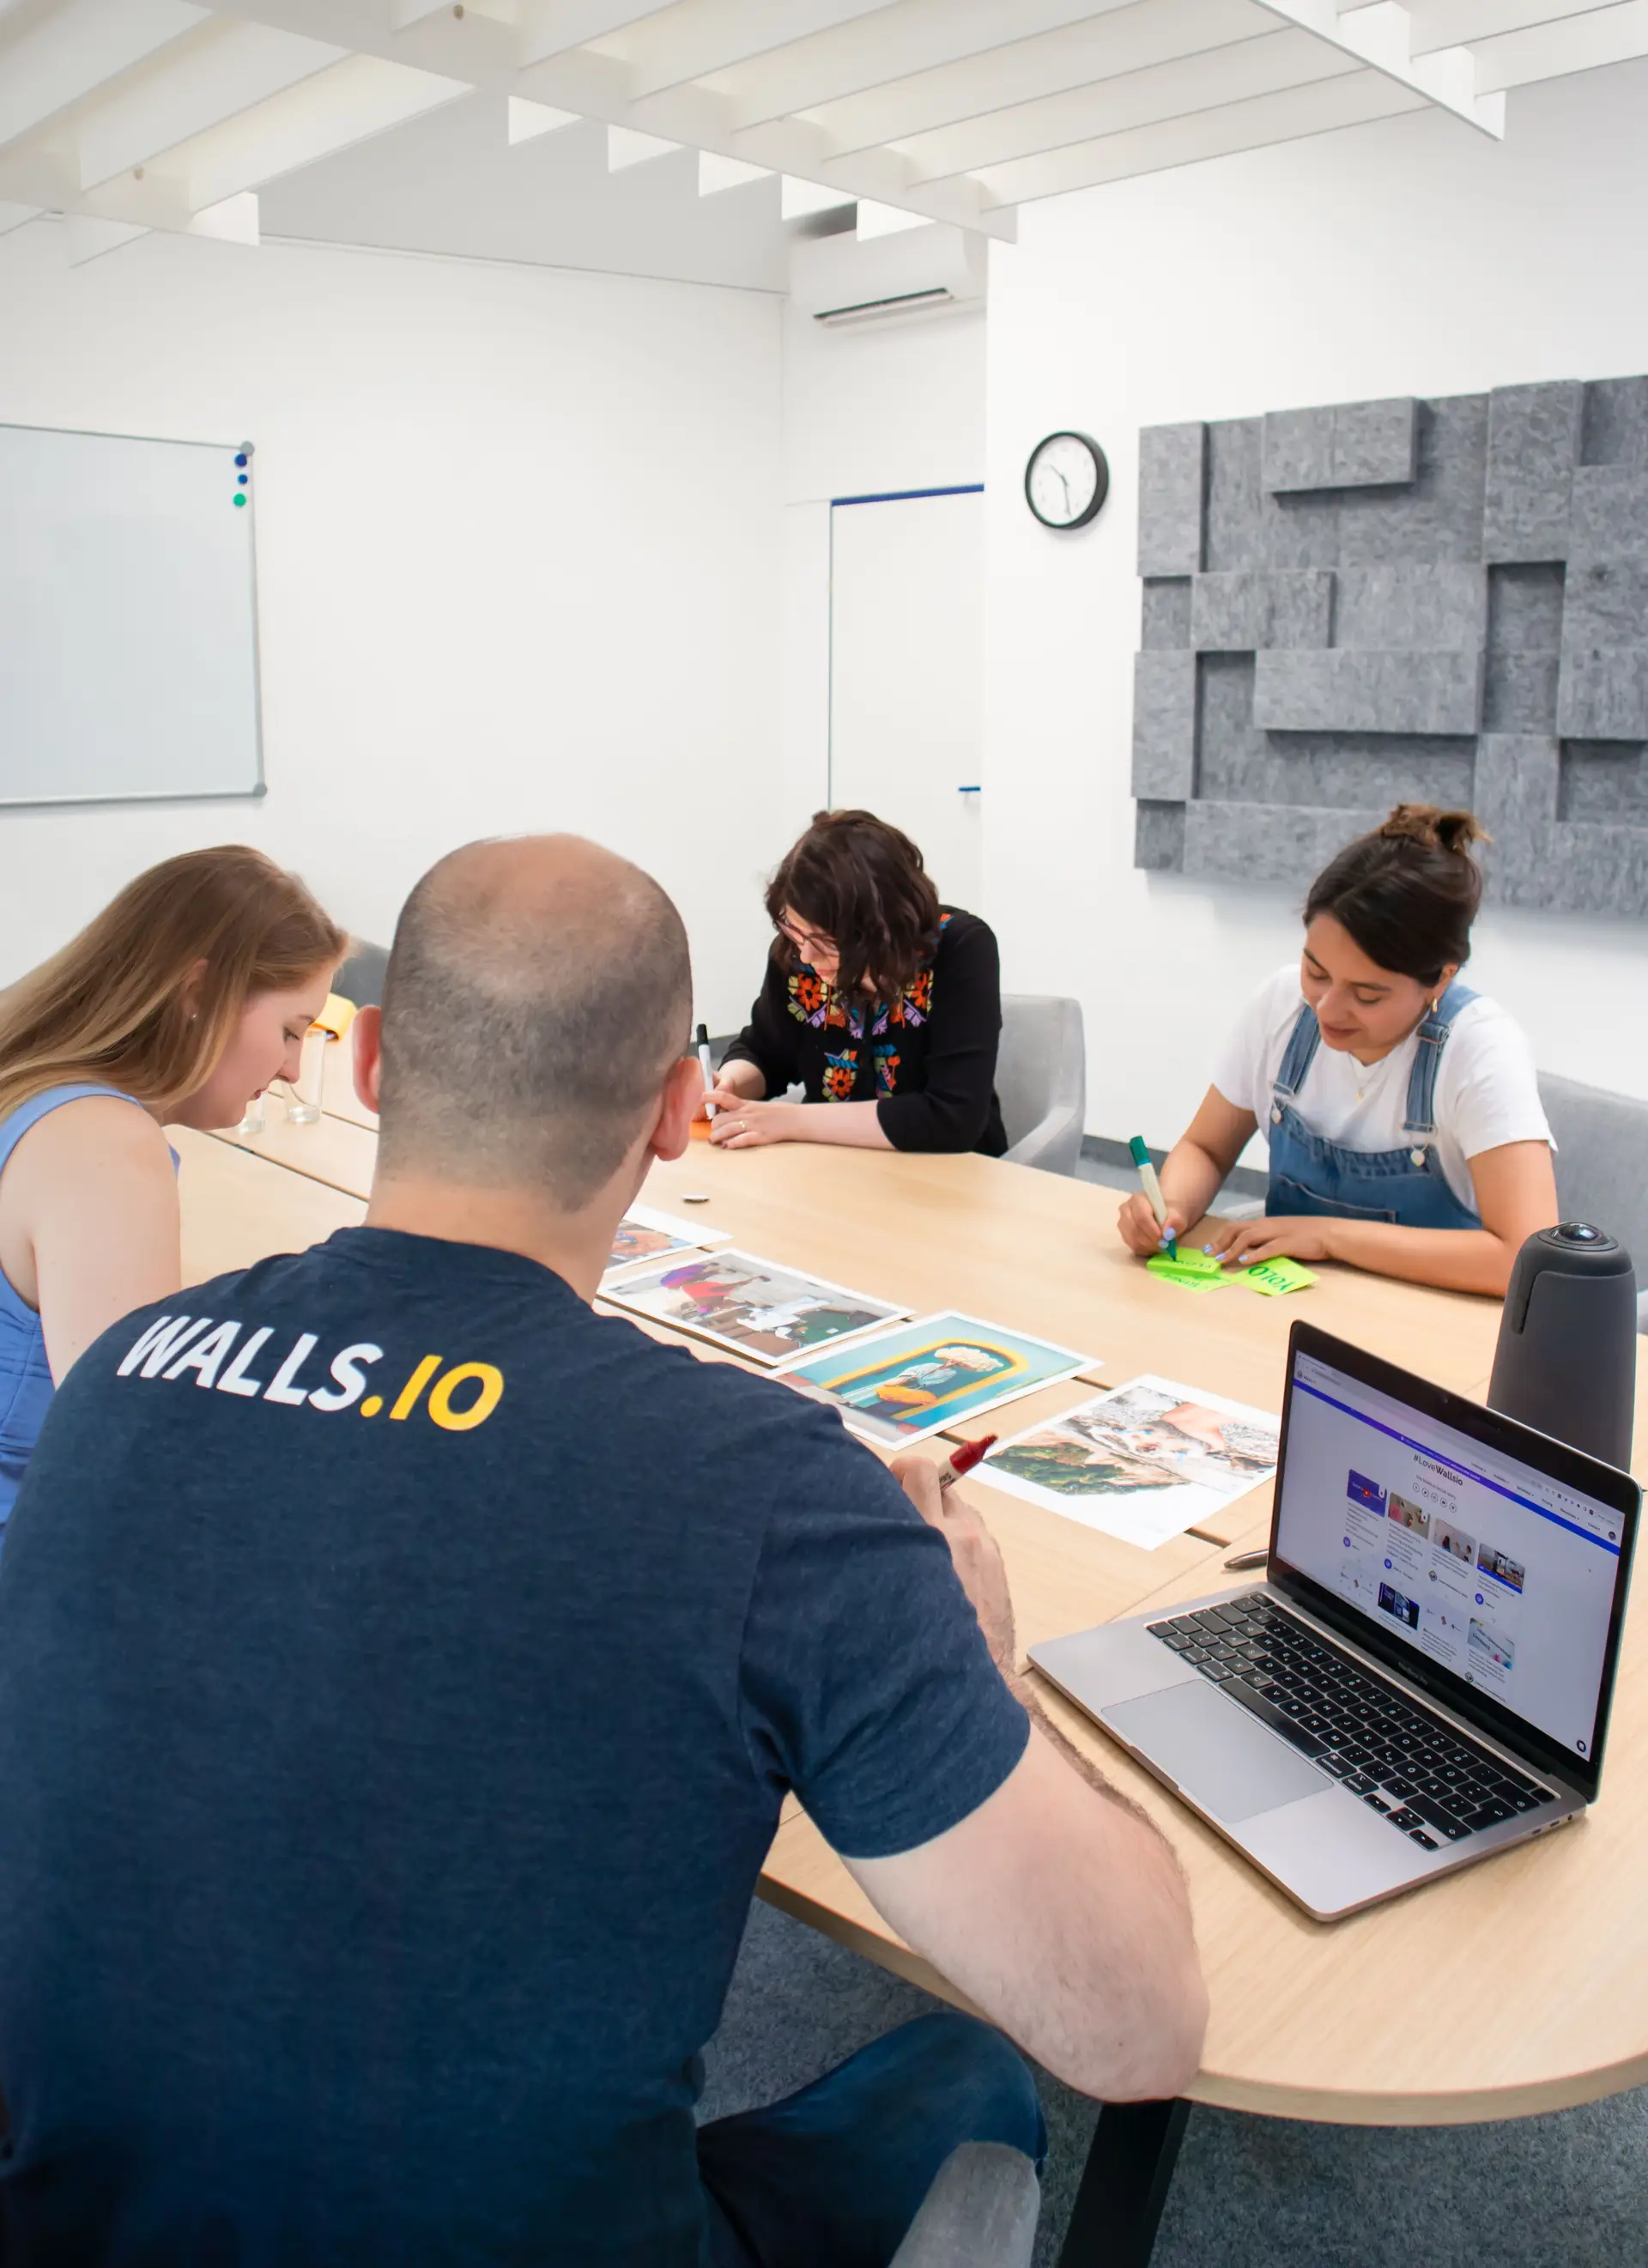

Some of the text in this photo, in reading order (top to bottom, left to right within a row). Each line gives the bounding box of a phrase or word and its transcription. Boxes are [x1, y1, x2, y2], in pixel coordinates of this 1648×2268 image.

[1248, 1265, 1295, 1292] YOLO
[116, 1315, 504, 1432] WALLS.IO
[1413, 1454, 1463, 1486] #LoveWallsio
